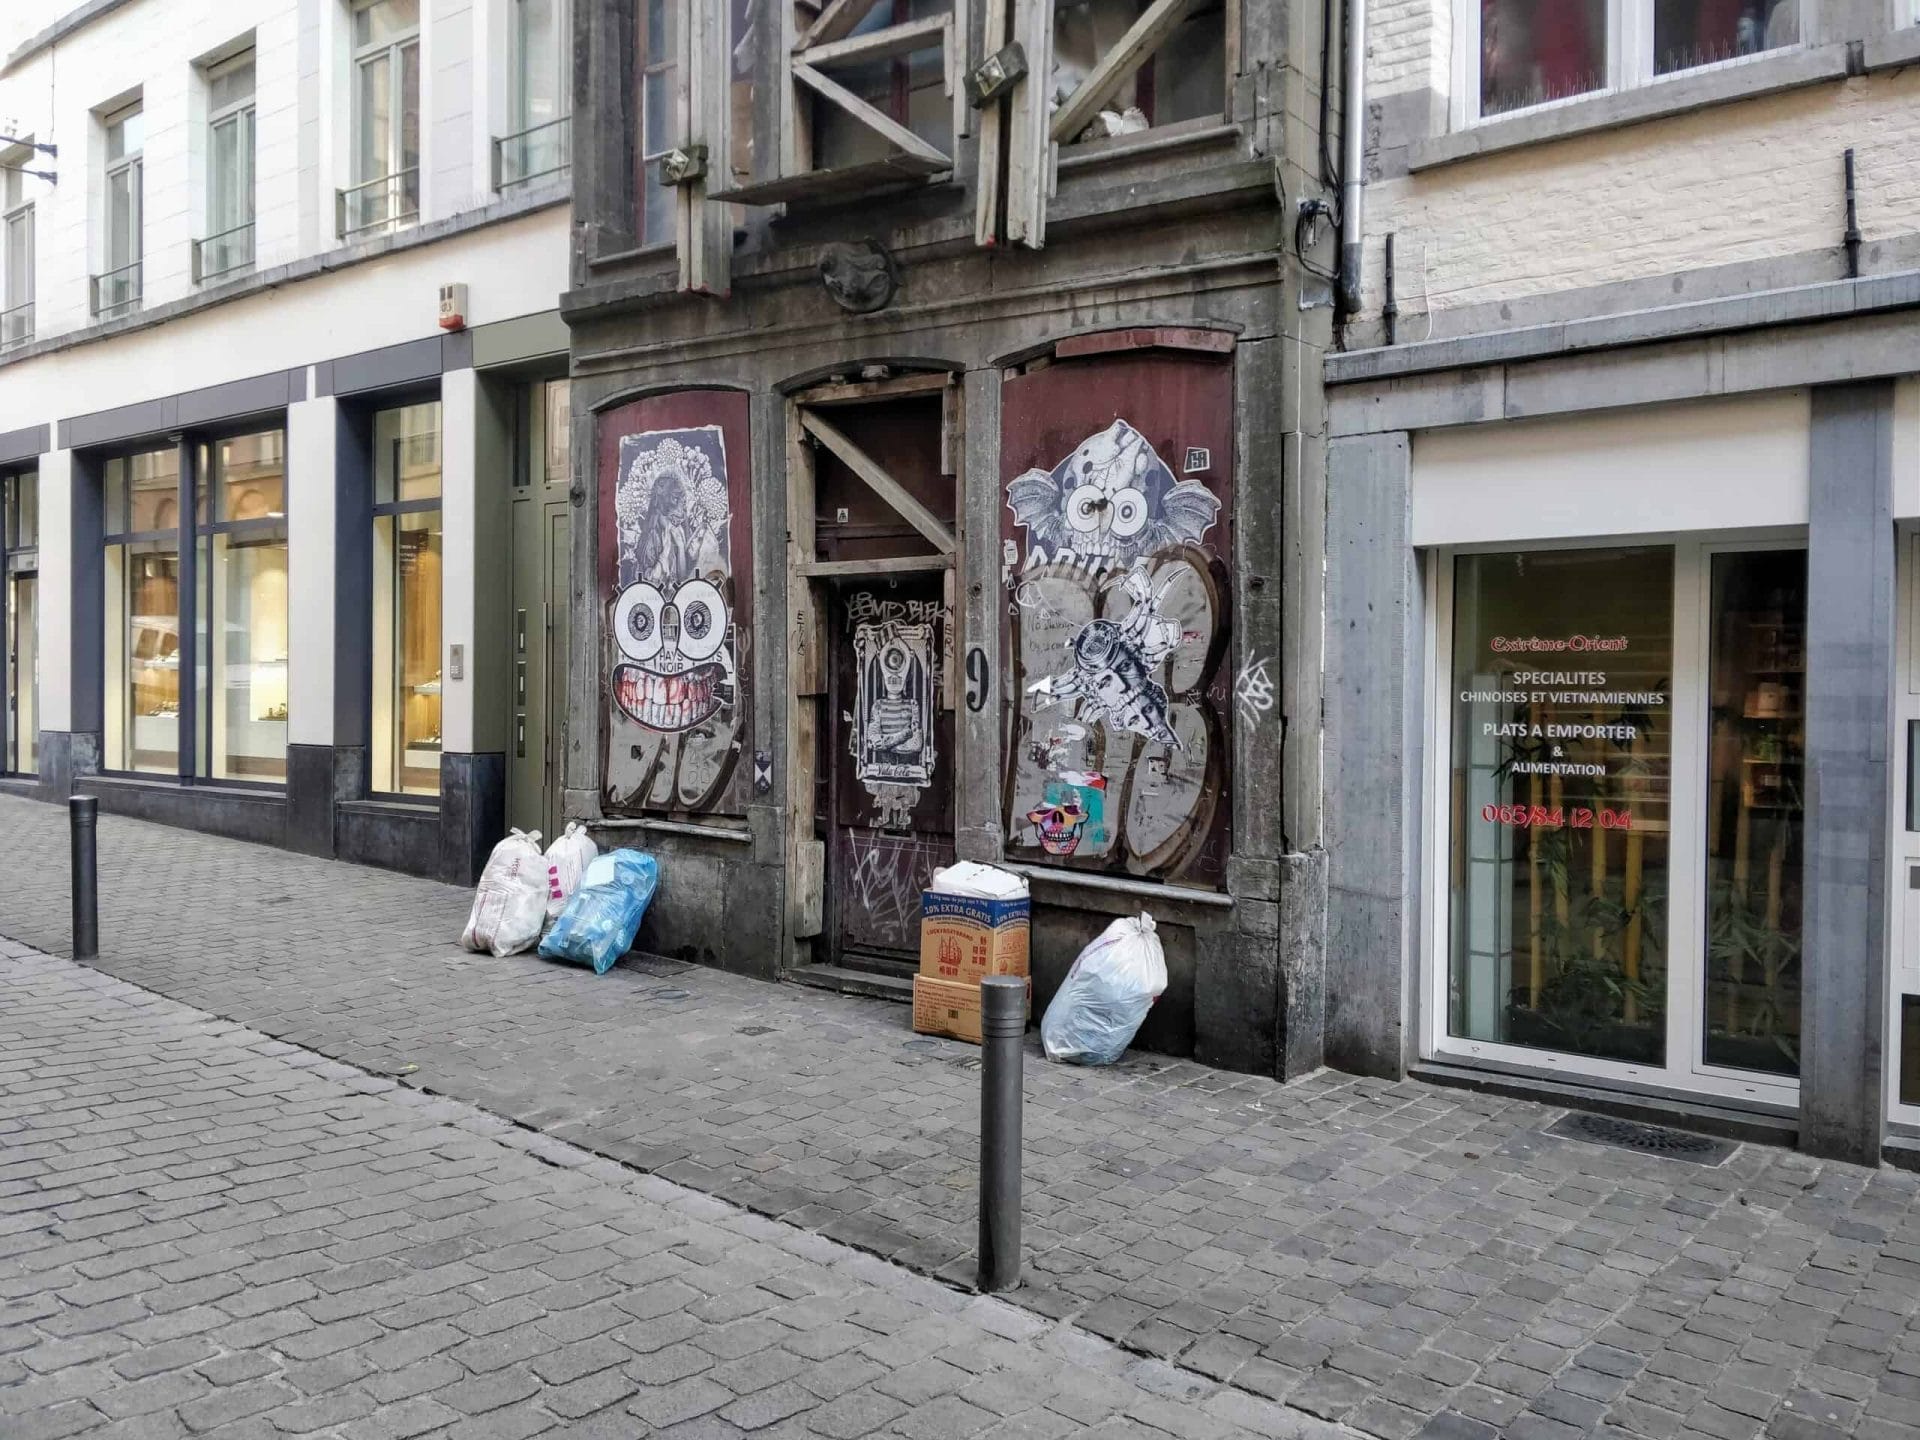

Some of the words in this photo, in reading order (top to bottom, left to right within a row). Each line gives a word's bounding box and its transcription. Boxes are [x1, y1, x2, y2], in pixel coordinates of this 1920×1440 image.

[660, 663, 684, 672] NOIR
[967, 647, 989, 712] 9
[1513, 672, 1606, 685] SPECIALITES
[1460, 691, 1528, 703] CHINOISES
[1531, 692, 1546, 703] ET
[1549, 692, 1665, 705] VIETNAMIENNES
[1483, 723, 1527, 736] PLATS
[1531, 725, 1543, 737] A
[1547, 725, 1636, 739] EMPORTER
[1553, 746, 1563, 757] &
[1511, 763, 1606, 776] ALIMENTATION
[1481, 804, 1564, 828] 065/84
[1571, 808, 1594, 828] 12
[1600, 808, 1633, 829] 04
[925, 905, 939, 914] 10%
[941, 905, 964, 914] EXTRA
[965, 908, 991, 923] GRATIS
